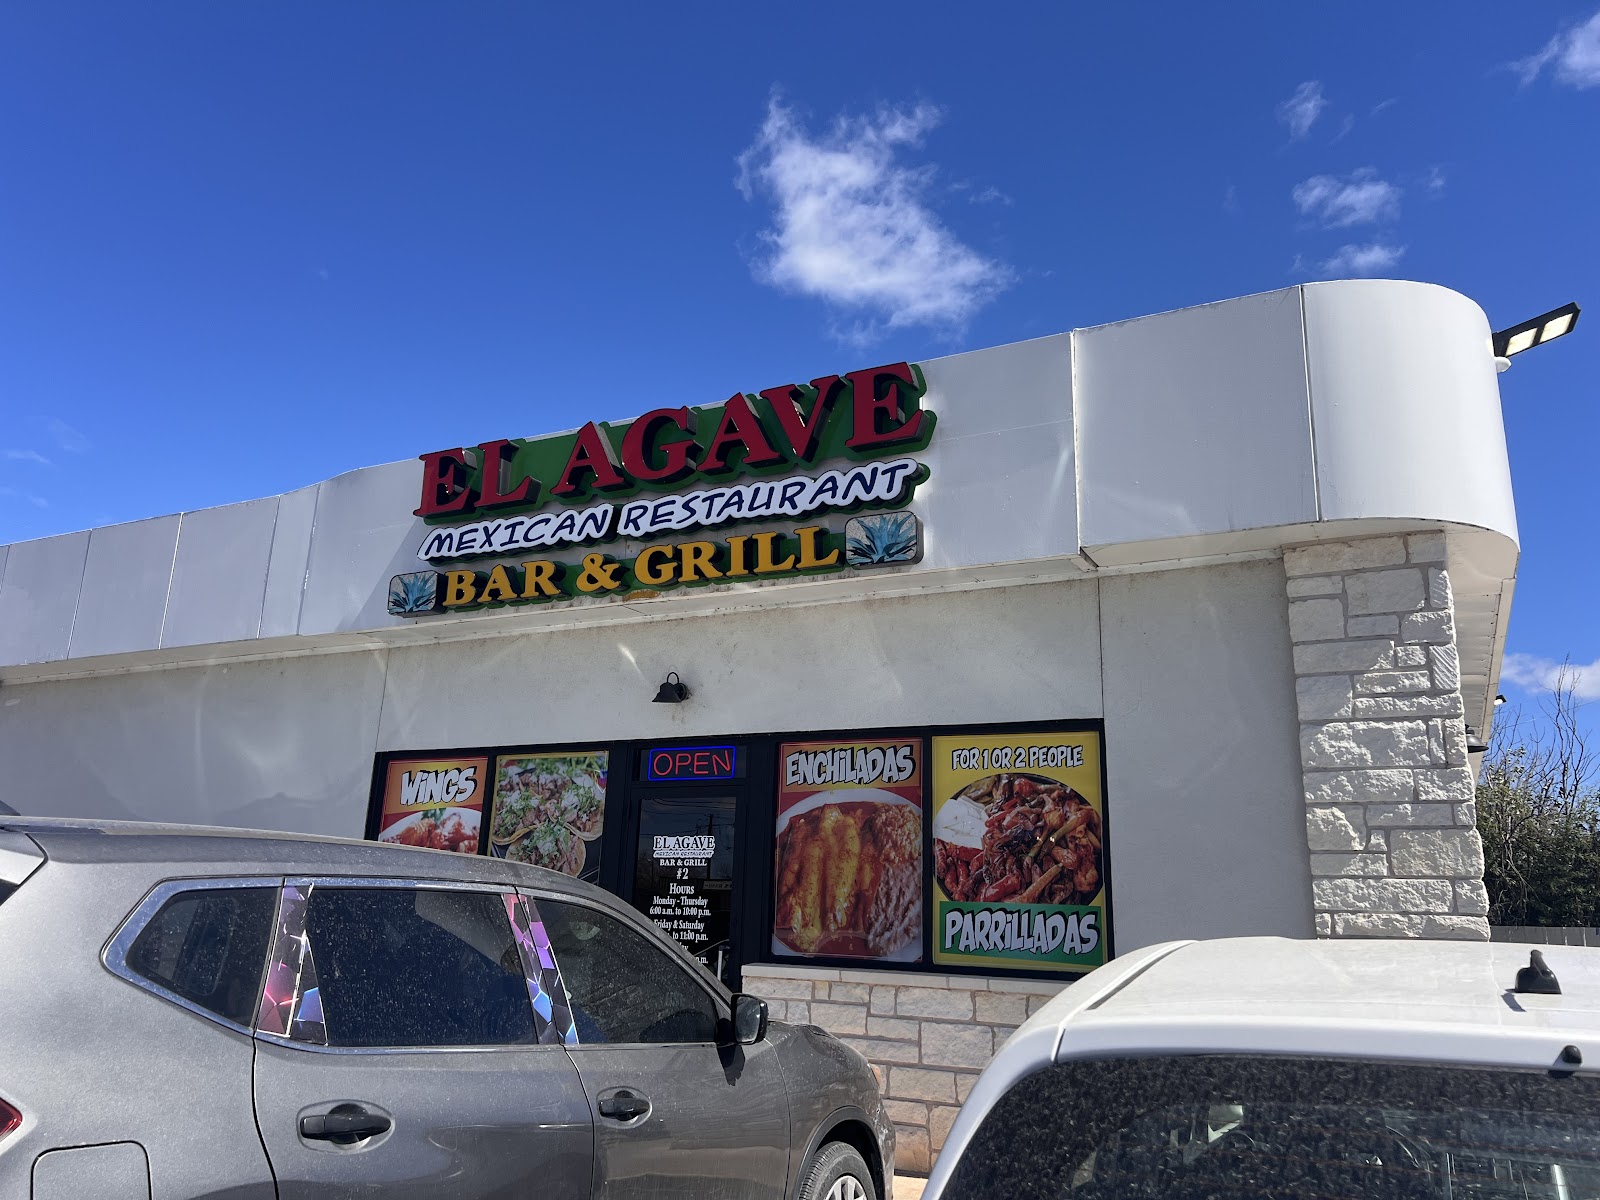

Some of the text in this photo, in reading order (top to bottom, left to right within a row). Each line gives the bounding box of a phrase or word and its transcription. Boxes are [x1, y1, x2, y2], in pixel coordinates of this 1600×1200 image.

[414, 361, 924, 518] EL AGAVE
[418, 461, 916, 559] MEXICAN RESTAURANT
[442, 525, 839, 606] BAR & GRILL
[654, 750, 730, 776] OPEN
[952, 745, 1083, 770] FOR 1 OR 2 PEOPLE
[654, 836, 715, 849] EL AGAVE
[676, 868, 688, 879] #2
[653, 896, 676, 907] Monday
[680, 896, 708, 908] Thursday
[650, 906, 661, 915] 6:00
[675, 907, 681, 915] to
[683, 907, 697, 916] 10:00
[698, 909, 711, 918] p.m.
[673, 920, 678, 929] &
[679, 920, 705, 932] Saturday
[672, 931, 708, 943] to 11:00 p.m.
